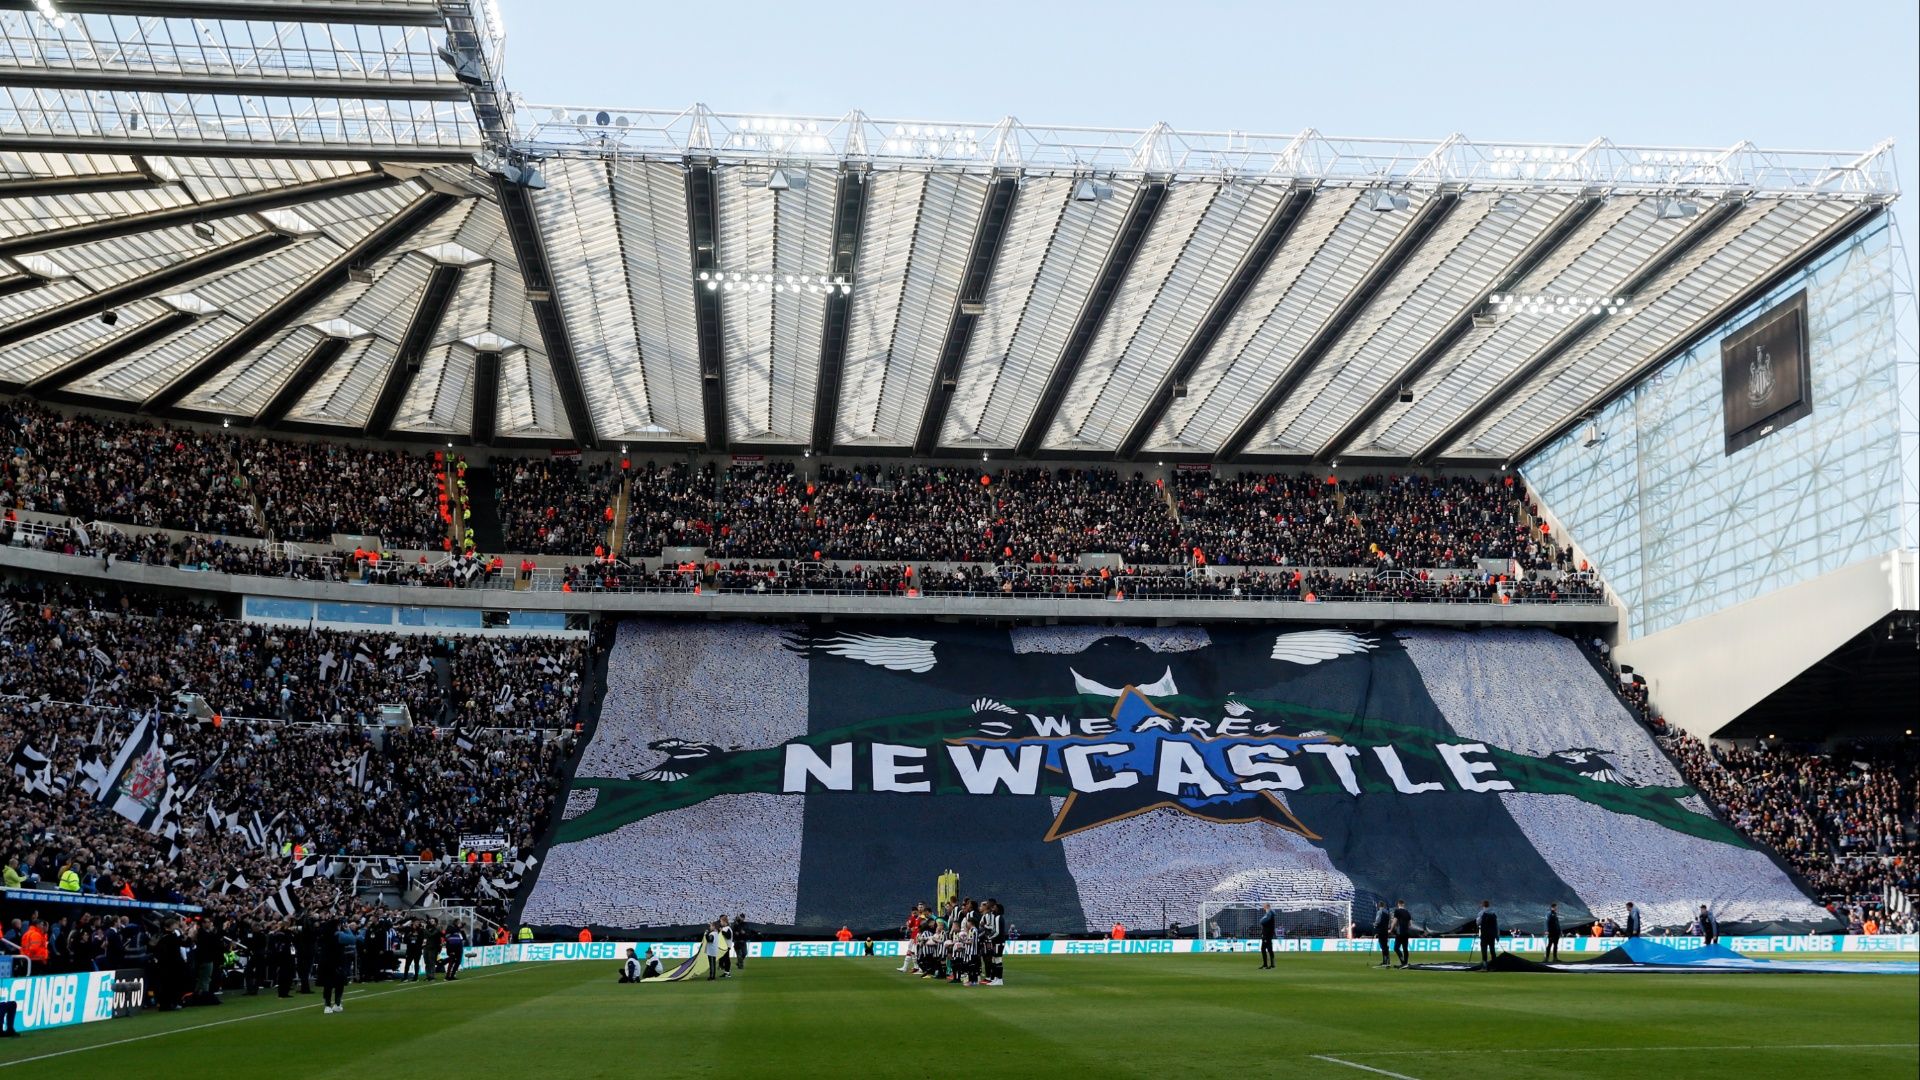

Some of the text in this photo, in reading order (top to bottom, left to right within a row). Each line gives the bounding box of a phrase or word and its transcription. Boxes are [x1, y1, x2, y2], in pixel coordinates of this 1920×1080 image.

[1026, 713, 1251, 741] WE ARE
[783, 740, 1515, 797] NEWCASTLE
[552, 943, 616, 959] FUN88
[1107, 940, 1174, 953] FUN88
[1511, 938, 1574, 951] FUN8
[1770, 936, 1833, 951] FUN88
[11, 974, 78, 1027] FUN88
